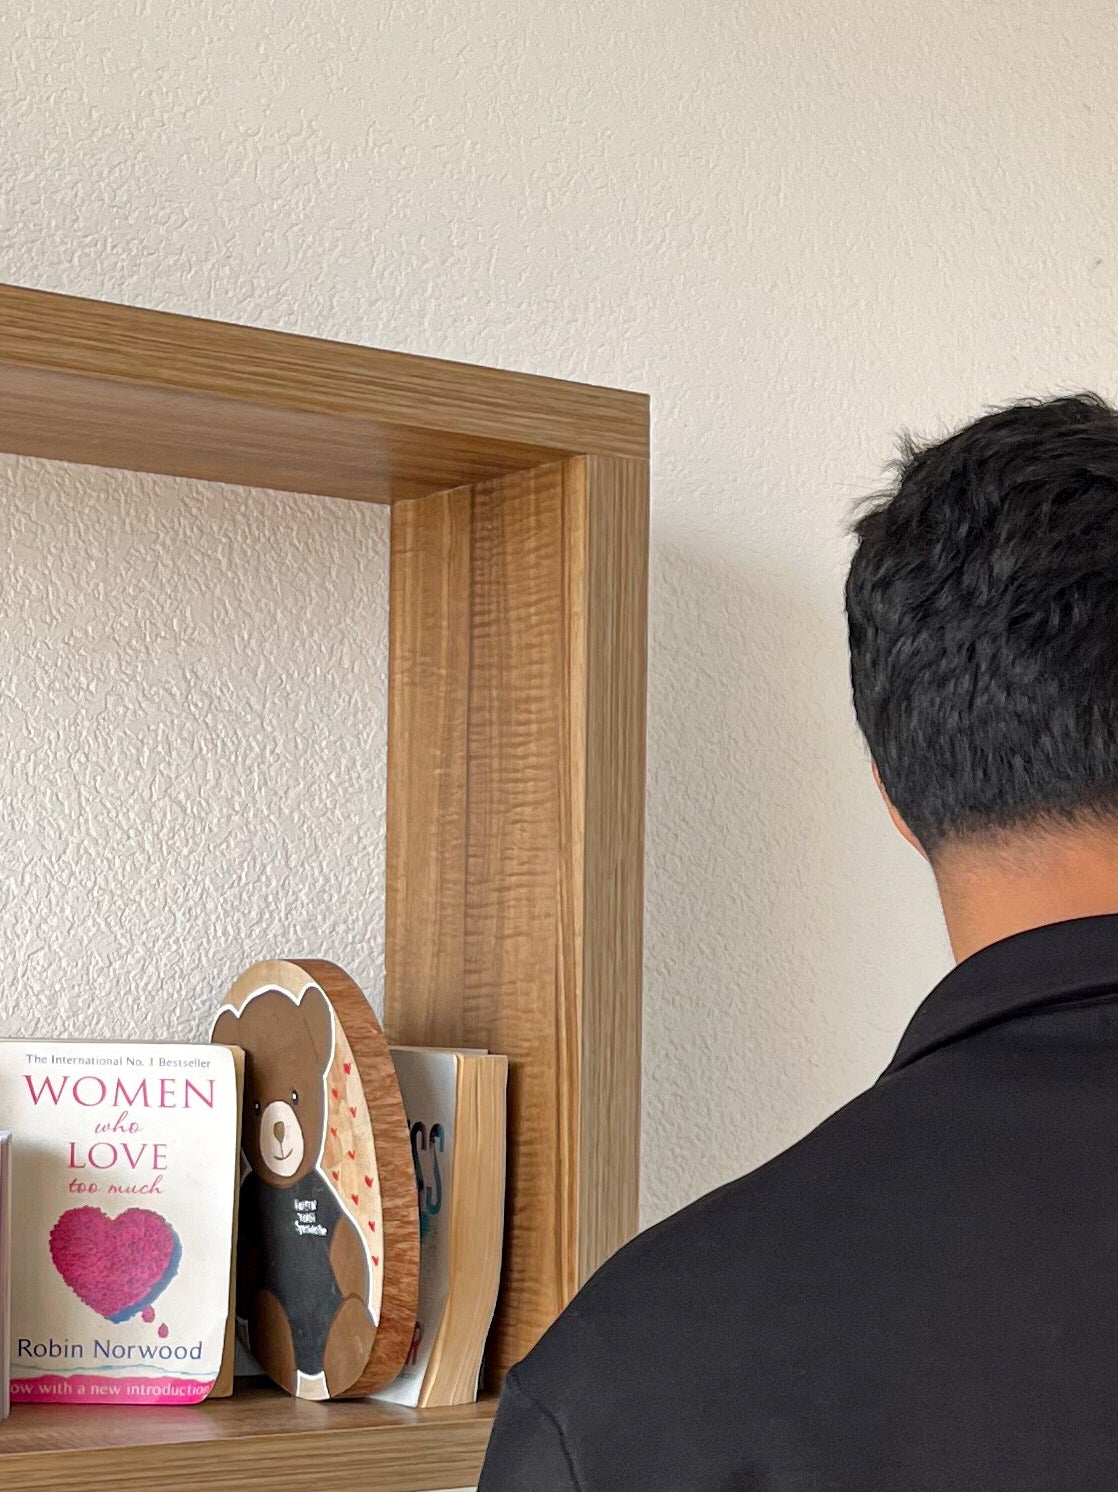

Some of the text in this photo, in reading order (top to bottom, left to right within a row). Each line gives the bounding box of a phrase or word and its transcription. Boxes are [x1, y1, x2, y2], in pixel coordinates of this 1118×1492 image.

[26, 1054, 48, 1064] The
[51, 1055, 123, 1066] International
[126, 1057, 144, 1067] No.
[159, 1058, 211, 1068] Bestseller
[22, 1074, 216, 1109] WOMEN
[94, 1111, 141, 1134] who
[68, 1142, 168, 1170] LOVE
[68, 1175, 163, 1194] too much
[18, 1338, 203, 1360] Robin Norwood
[10, 1383, 33, 1394] ow
[39, 1381, 73, 1395] with
[77, 1384, 86, 1395] a
[91, 1384, 121, 1395] new
